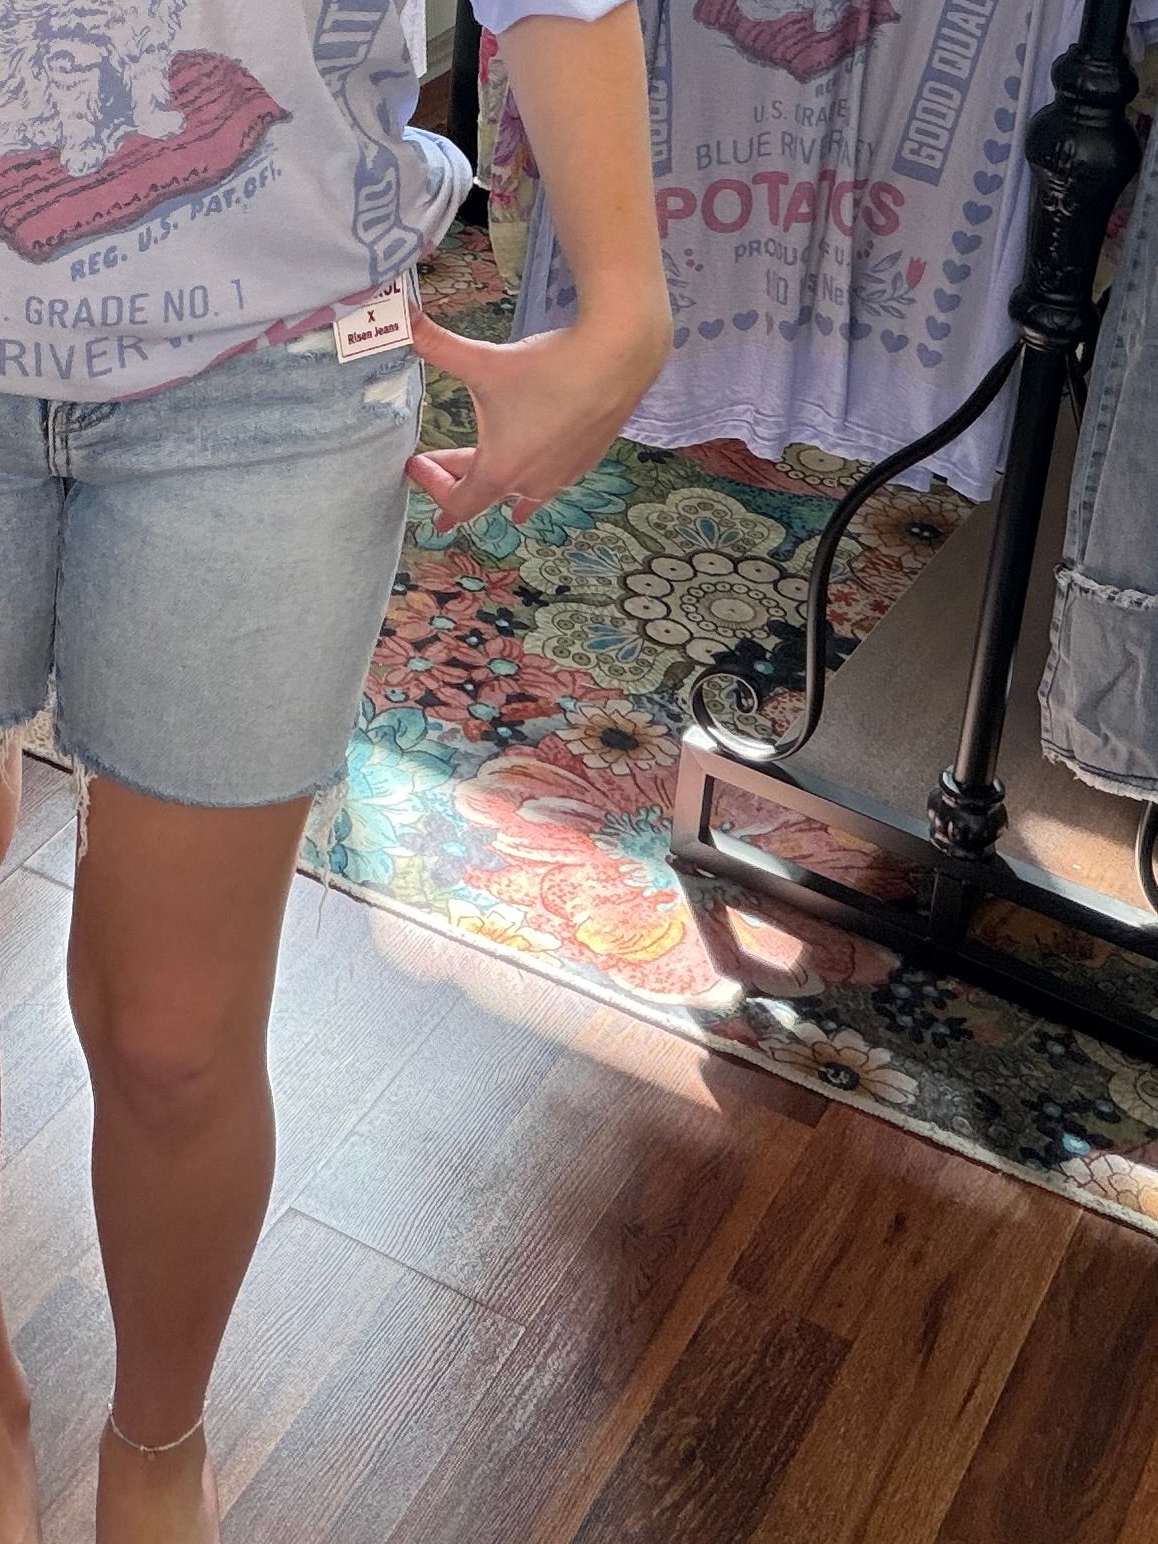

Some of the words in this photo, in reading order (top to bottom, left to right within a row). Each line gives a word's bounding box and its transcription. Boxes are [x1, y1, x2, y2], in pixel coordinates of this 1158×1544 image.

[753, 99, 788, 123] U.S.
[900, 79, 962, 169] GOOD
[696, 131, 772, 171] BLUE
[69, 244, 129, 282] REG.
[138, 213, 189, 253] U.S.
[24, 292, 149, 329] GRADE
[163, 284, 220, 321] NO.
[230, 279, 245, 310] 1
[347, 331, 373, 345] Risen
[374, 322, 399, 338] Jeans
